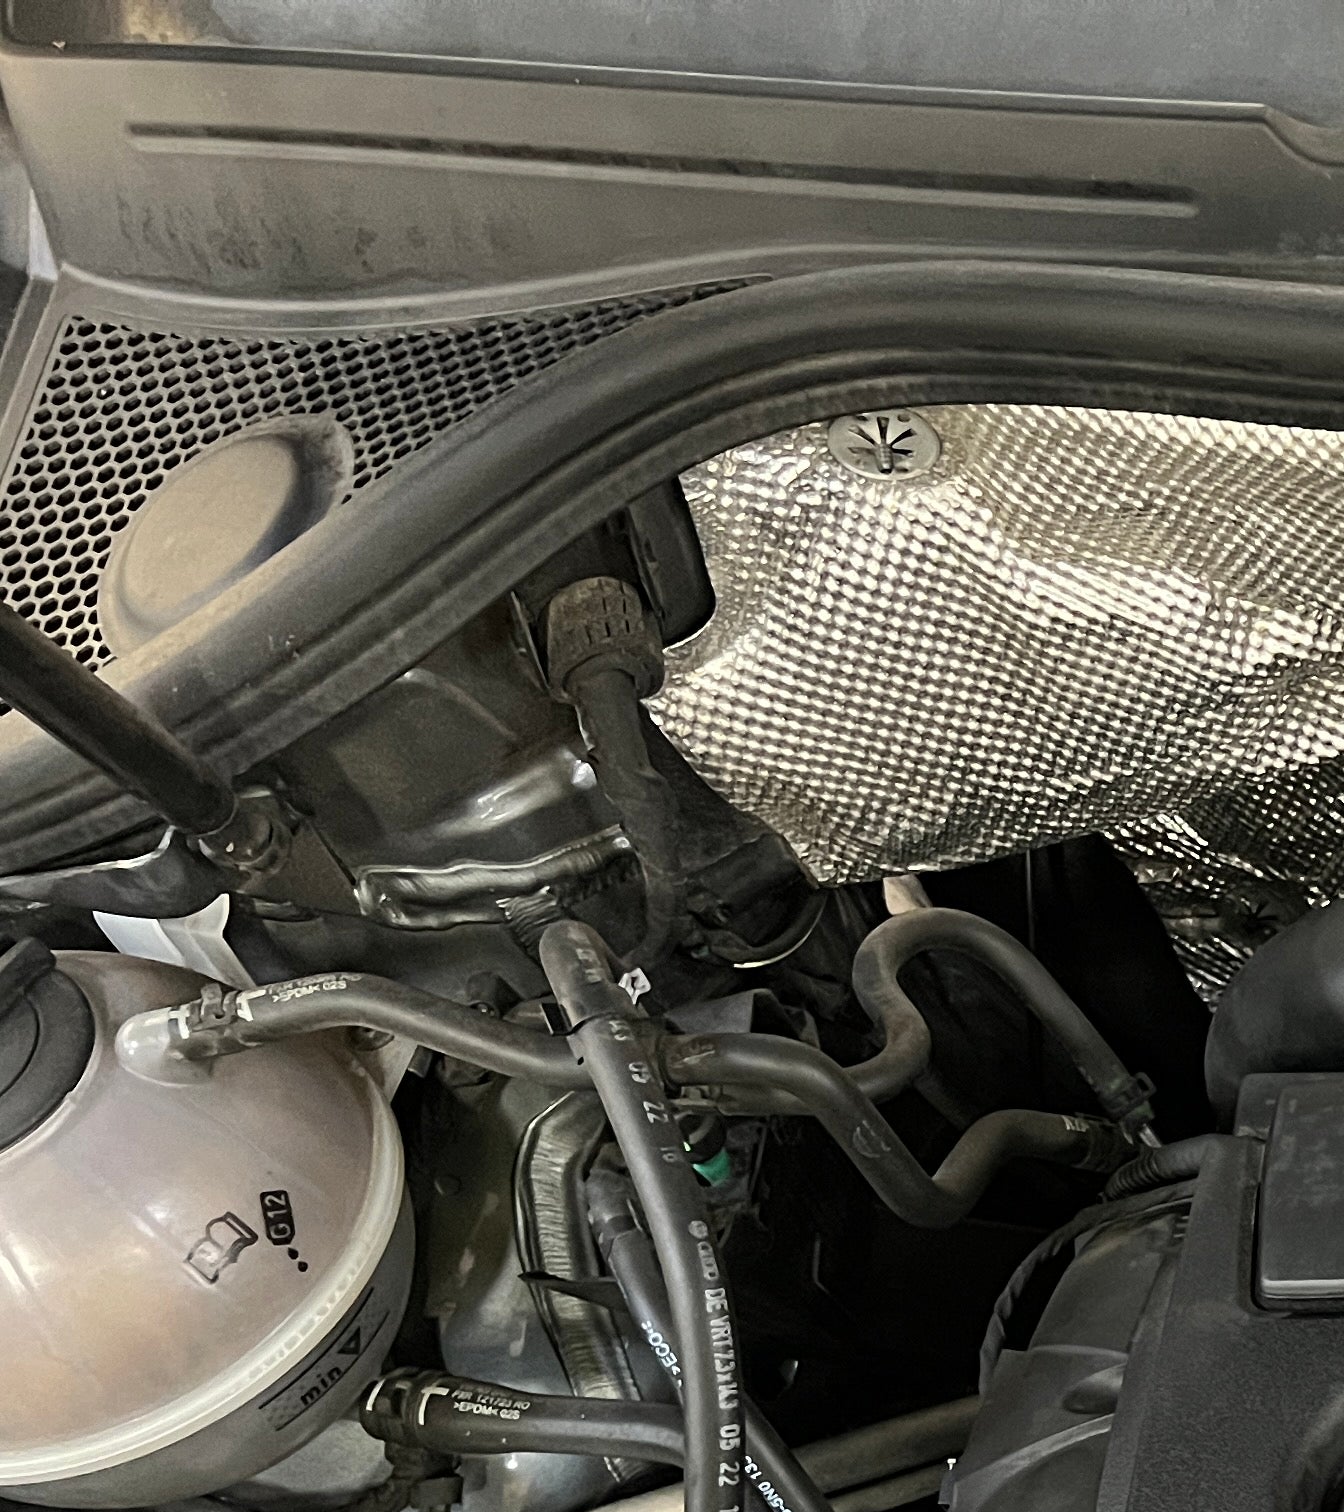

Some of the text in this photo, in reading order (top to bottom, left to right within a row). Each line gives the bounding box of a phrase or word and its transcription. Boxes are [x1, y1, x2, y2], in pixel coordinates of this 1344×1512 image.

[264, 1192, 292, 1240] G12
[705, 1287, 728, 1313] DE
[300, 1366, 343, 1407] min
[719, 1423, 741, 1451] 05
[718, 1461, 740, 1487] 22
